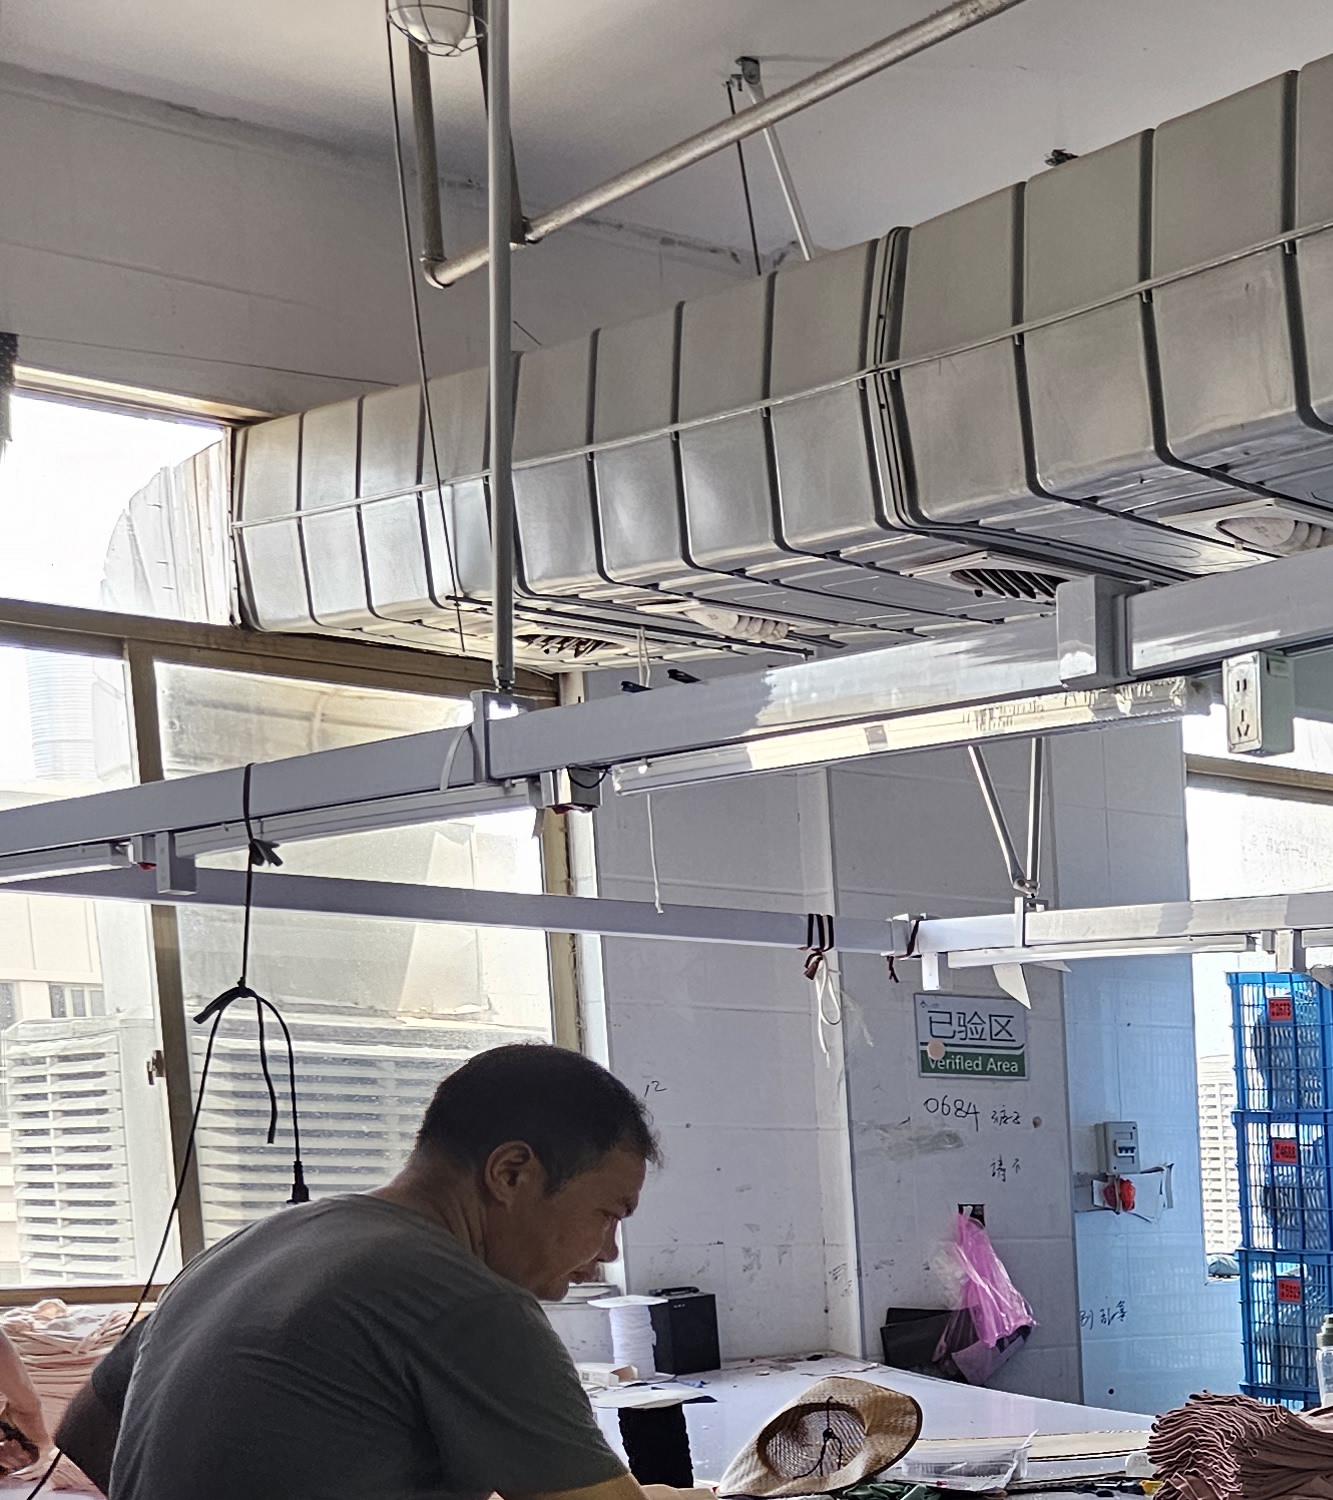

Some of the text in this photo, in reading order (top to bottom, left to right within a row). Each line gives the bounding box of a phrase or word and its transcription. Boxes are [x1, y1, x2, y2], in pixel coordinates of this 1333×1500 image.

[927, 1010, 1016, 1042] 已验区
[986, 1057, 1019, 1073] Area
[924, 1095, 980, 1132] 0684
